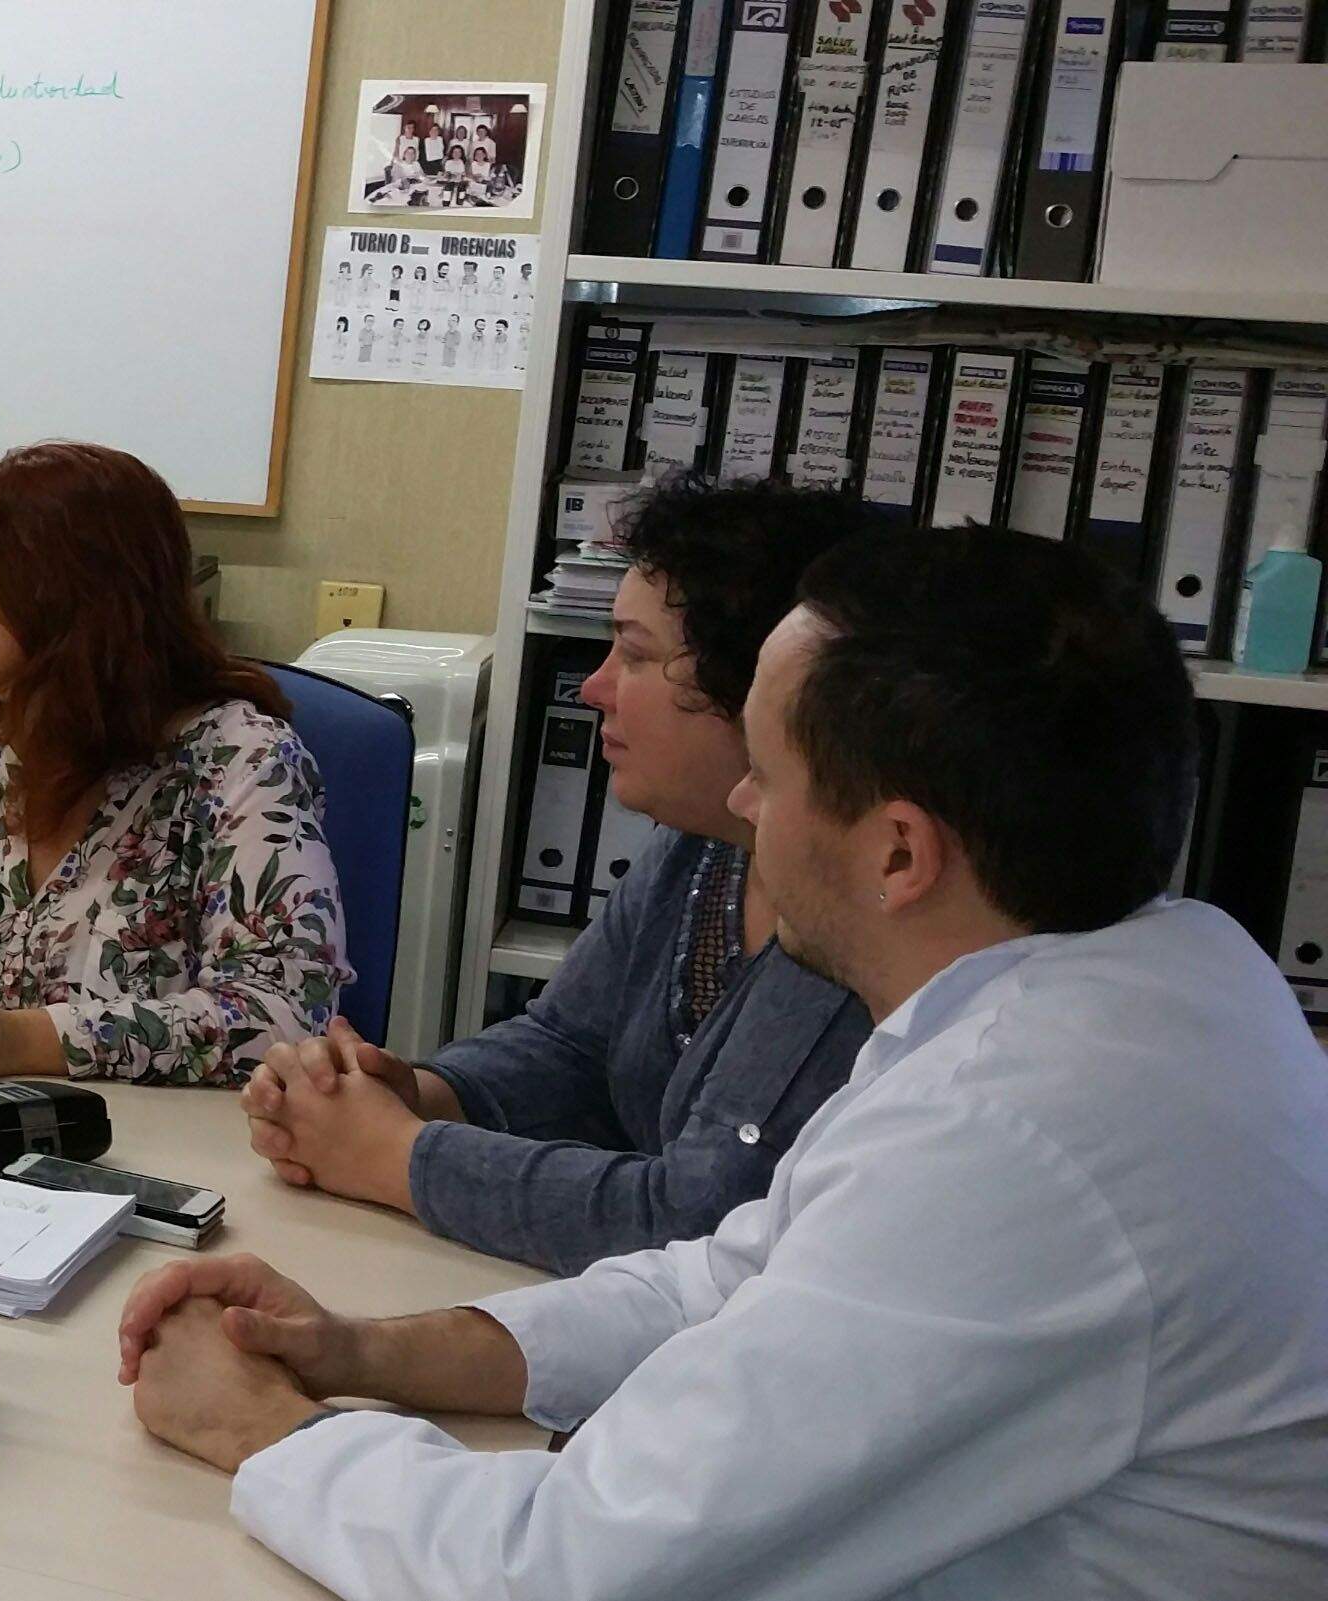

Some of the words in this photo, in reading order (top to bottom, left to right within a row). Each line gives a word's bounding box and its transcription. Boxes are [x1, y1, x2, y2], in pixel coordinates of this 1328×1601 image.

[350, 232, 397, 254] TURNO
[399, 235, 411, 254] B
[440, 236, 516, 259] URGENCIAS
